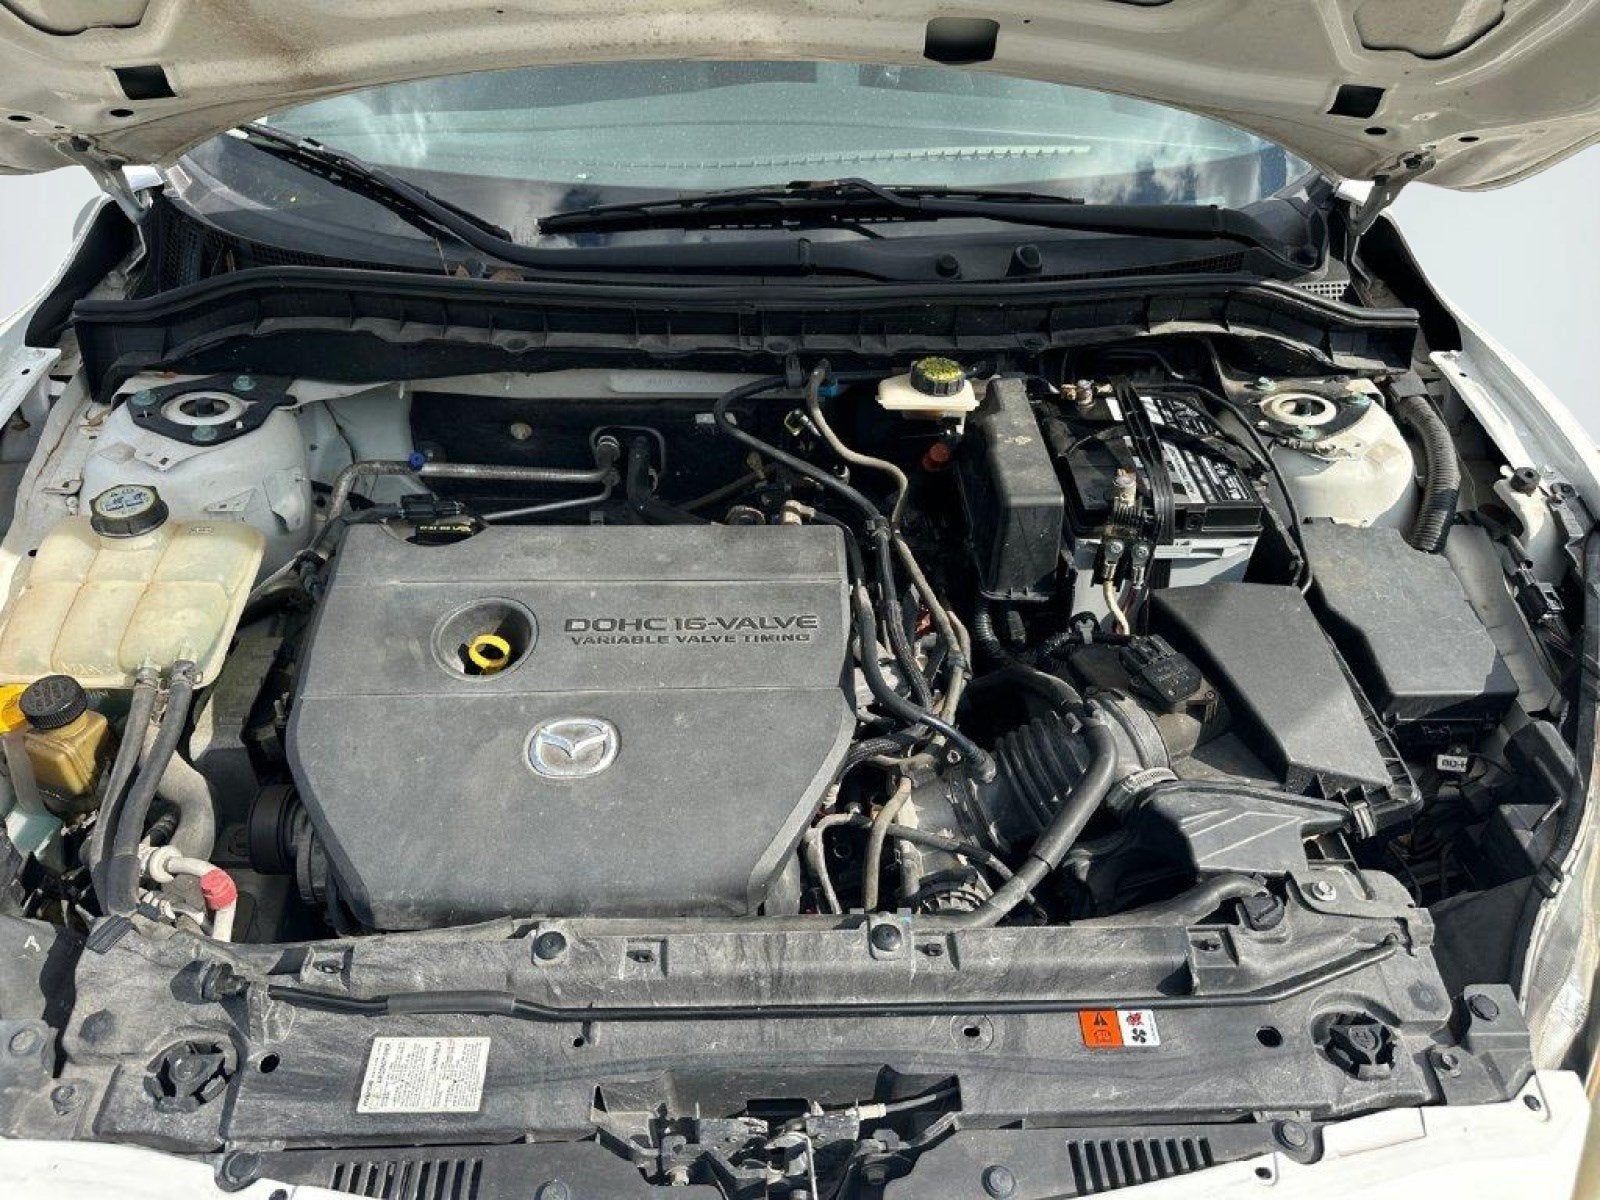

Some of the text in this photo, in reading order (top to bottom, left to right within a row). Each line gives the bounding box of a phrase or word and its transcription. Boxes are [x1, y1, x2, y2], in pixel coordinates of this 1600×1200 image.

[564, 615, 818, 632] DOHC 16-VALVE
[571, 633, 811, 645] VARIABLE VALVE TIMING
